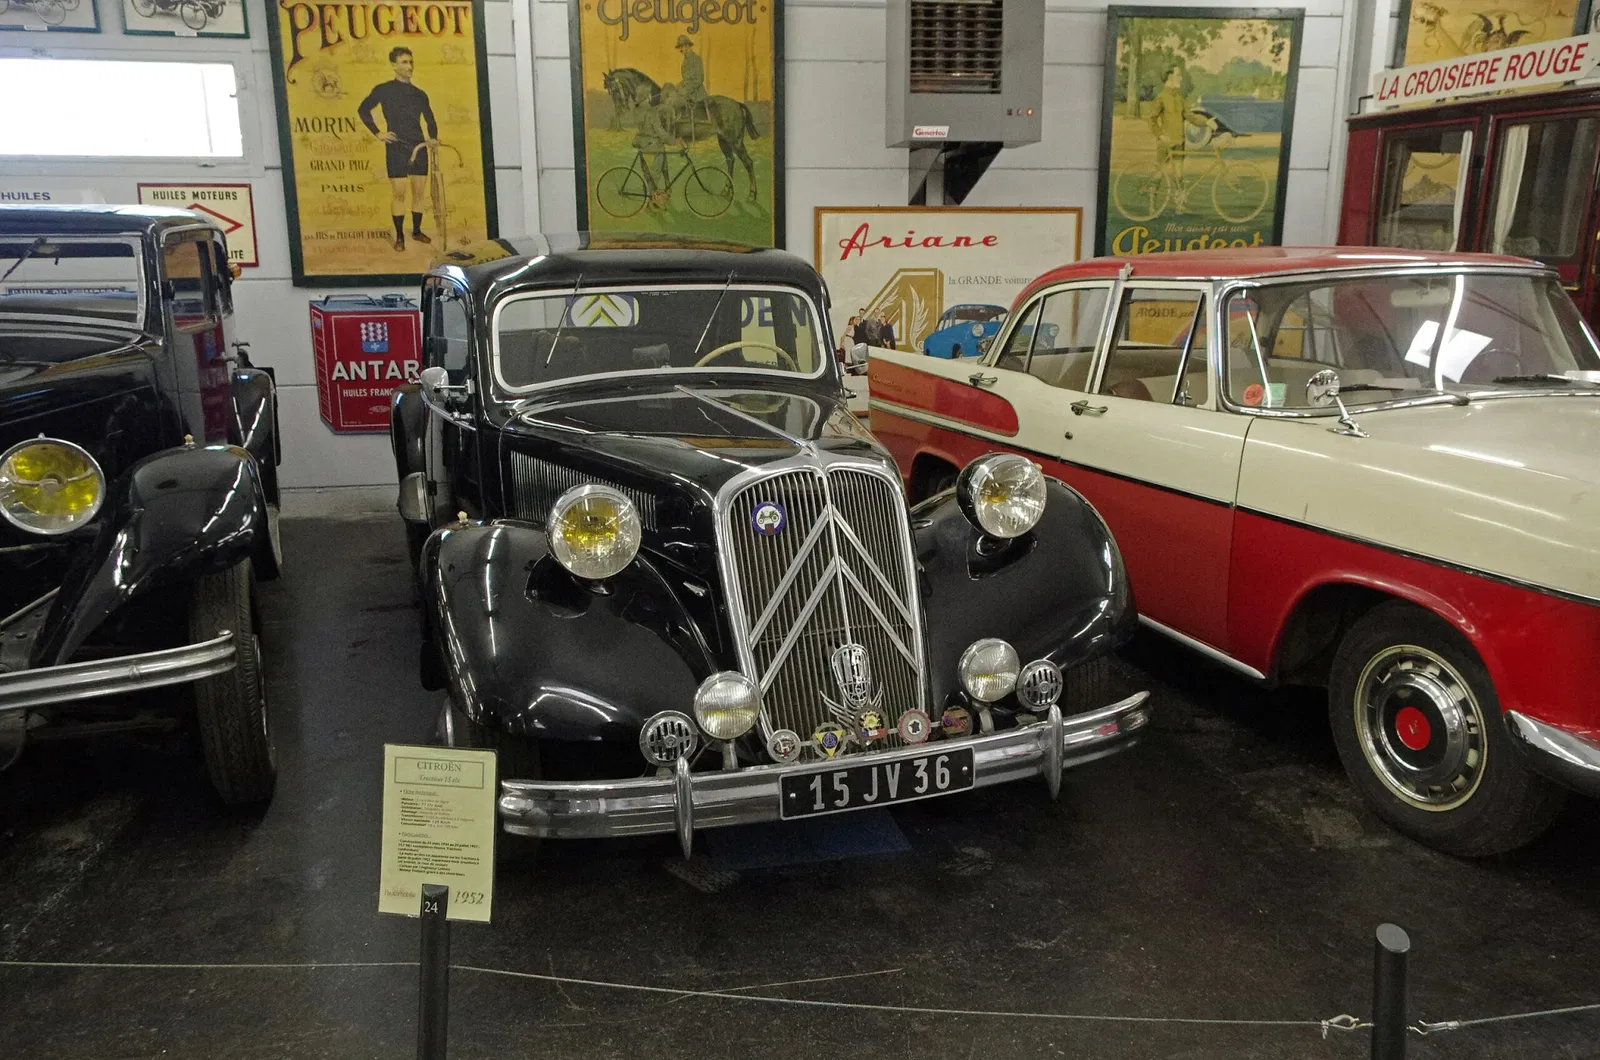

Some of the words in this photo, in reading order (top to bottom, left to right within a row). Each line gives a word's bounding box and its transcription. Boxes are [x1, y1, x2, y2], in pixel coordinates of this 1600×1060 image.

[281, 1, 469, 84] PEUGEOT
[1378, 75, 1400, 101] LA
[1403, 57, 1502, 97] CROISIERE
[1503, 42, 1589, 82] ROUGE
[294, 117, 356, 140] MORIN
[310, 160, 345, 171] GRAND
[321, 184, 366, 193] PARIS
[1, 191, 51, 201] HUILES
[152, 190, 186, 200] HUILES
[192, 190, 238, 201] MOTEURS
[839, 222, 998, 260] Ariane
[958, 275, 1002, 285] GRANDE
[332, 360, 420, 380] ANTAR
[343, 388, 367, 398] HUILES
[416, 761, 462, 772] CITROËN
[809, 773, 850, 811] 15
[863, 763, 900, 802] JV
[914, 755, 950, 793] 36
[454, 890, 485, 905] 1952
[424, 901, 439, 914] 24
